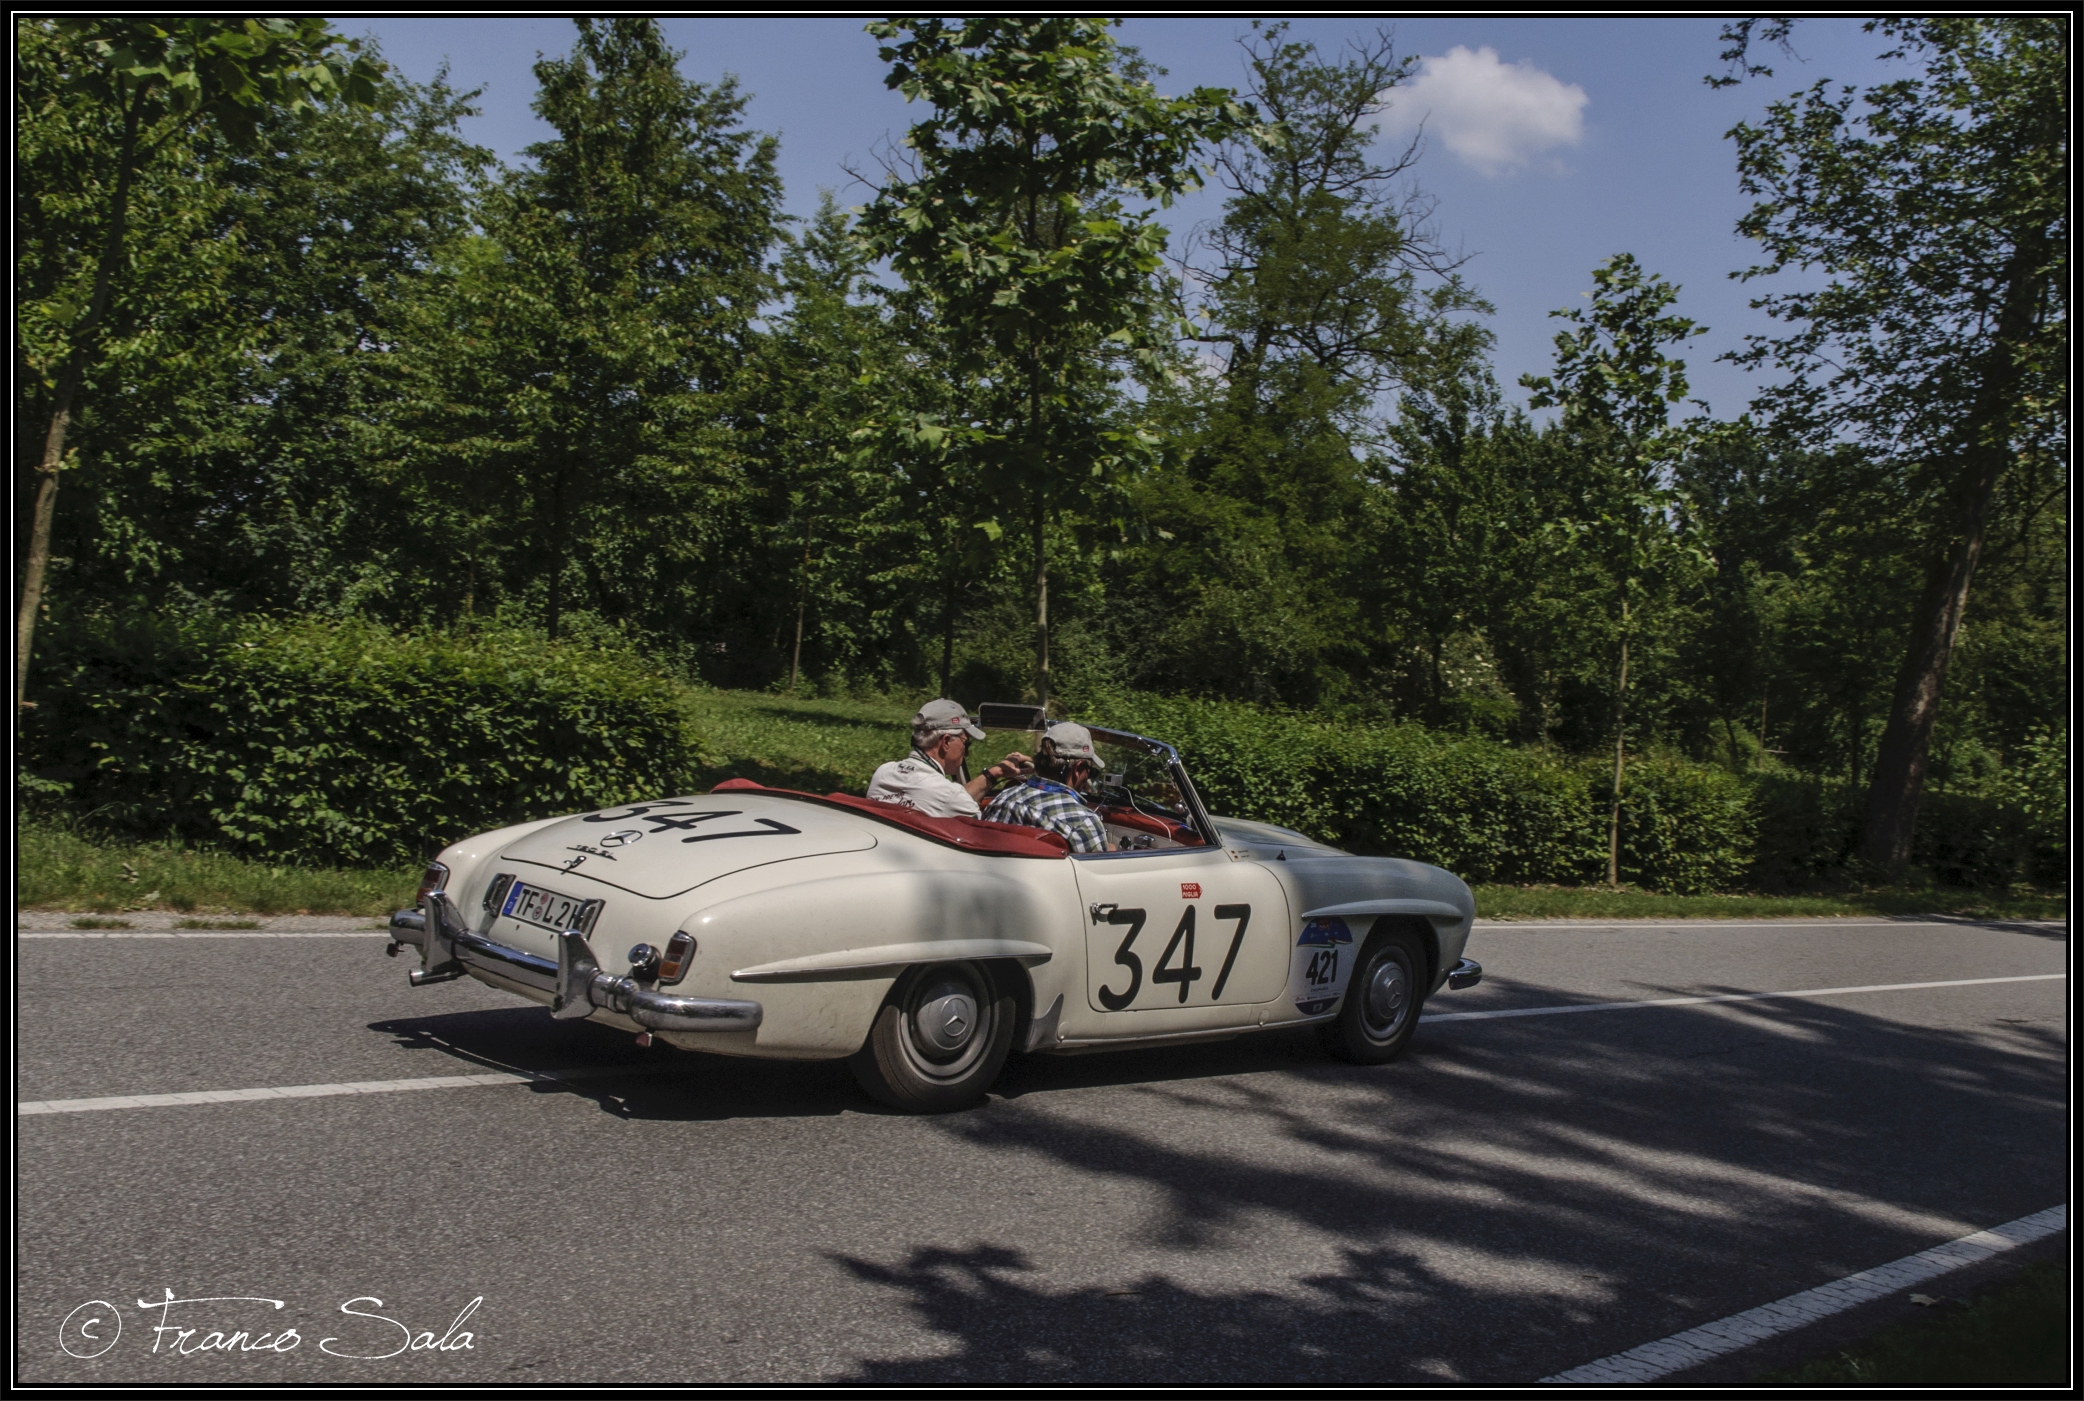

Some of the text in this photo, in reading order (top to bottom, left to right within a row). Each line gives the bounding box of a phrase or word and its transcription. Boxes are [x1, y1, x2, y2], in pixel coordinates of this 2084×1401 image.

[583, 800, 802, 843] 347
[516, 888, 540, 916] TF
[1098, 903, 1251, 1011] 347
[1305, 949, 1339, 986] 421
